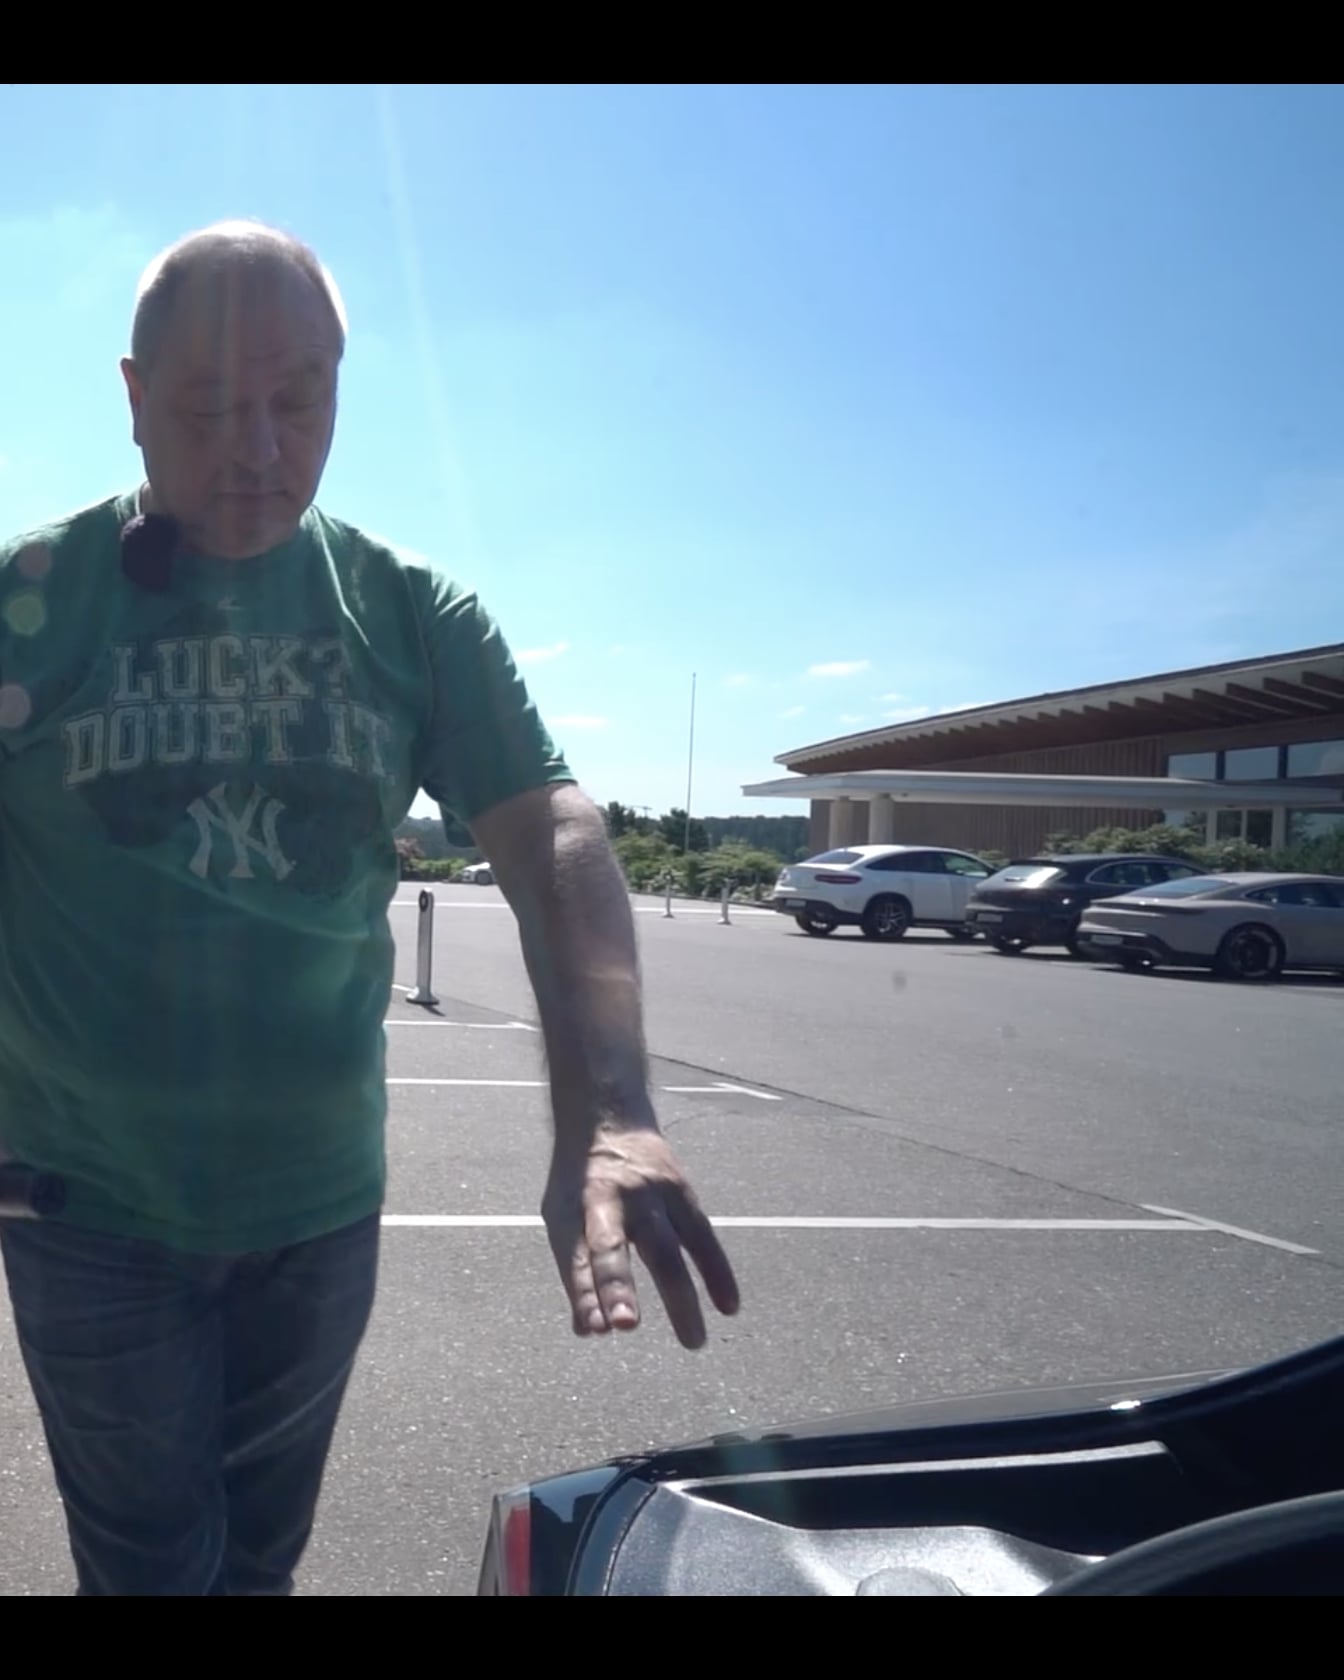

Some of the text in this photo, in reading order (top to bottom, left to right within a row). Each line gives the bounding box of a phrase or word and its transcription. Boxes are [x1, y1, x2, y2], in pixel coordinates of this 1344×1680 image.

[111, 633, 353, 702] LUCK?
[62, 697, 394, 790] DOUBT IT
[186, 781, 296, 881] NY
